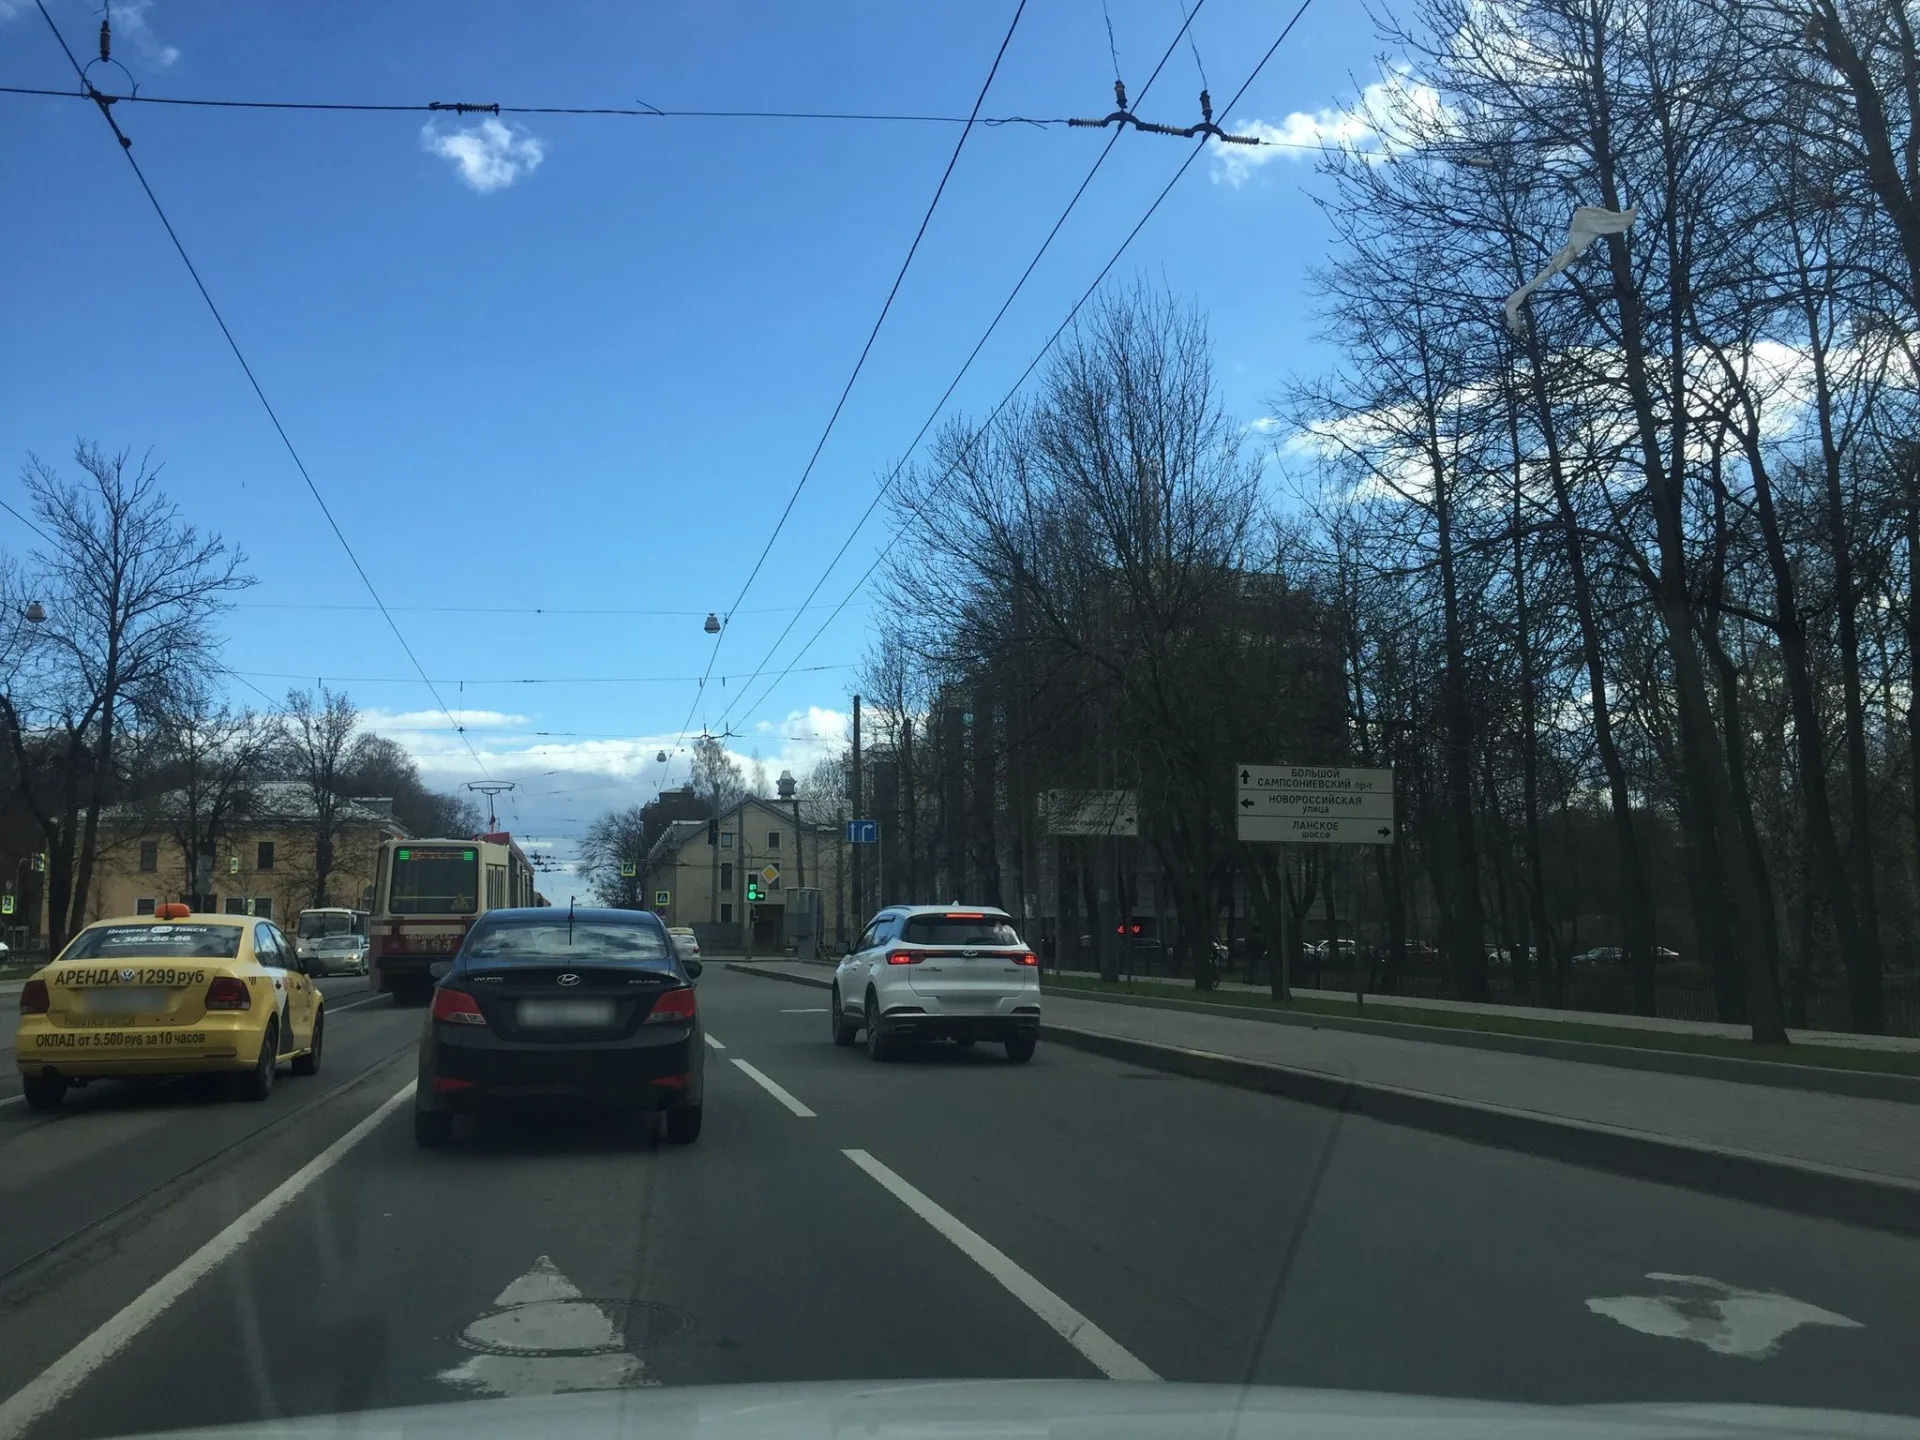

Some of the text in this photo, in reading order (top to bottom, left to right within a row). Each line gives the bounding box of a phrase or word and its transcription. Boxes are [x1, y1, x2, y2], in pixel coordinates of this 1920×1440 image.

[1291, 767, 1340, 779] БОЛЬШОЙ
[1257, 777, 1373, 791] САМПСОНИЕВСКИЙ пр-т
[1268, 794, 1362, 806] НОВОРОССИЙСКАЯ
[1302, 805, 1330, 815] улица
[1292, 821, 1339, 831] ЛАНСКОЕ
[1301, 831, 1331, 839] шоссе
[54, 968, 204, 986] АРЕНДА 1299 руб
[36, 1031, 205, 1047] ОКЛАД от 5.500 руб за 10 часов
